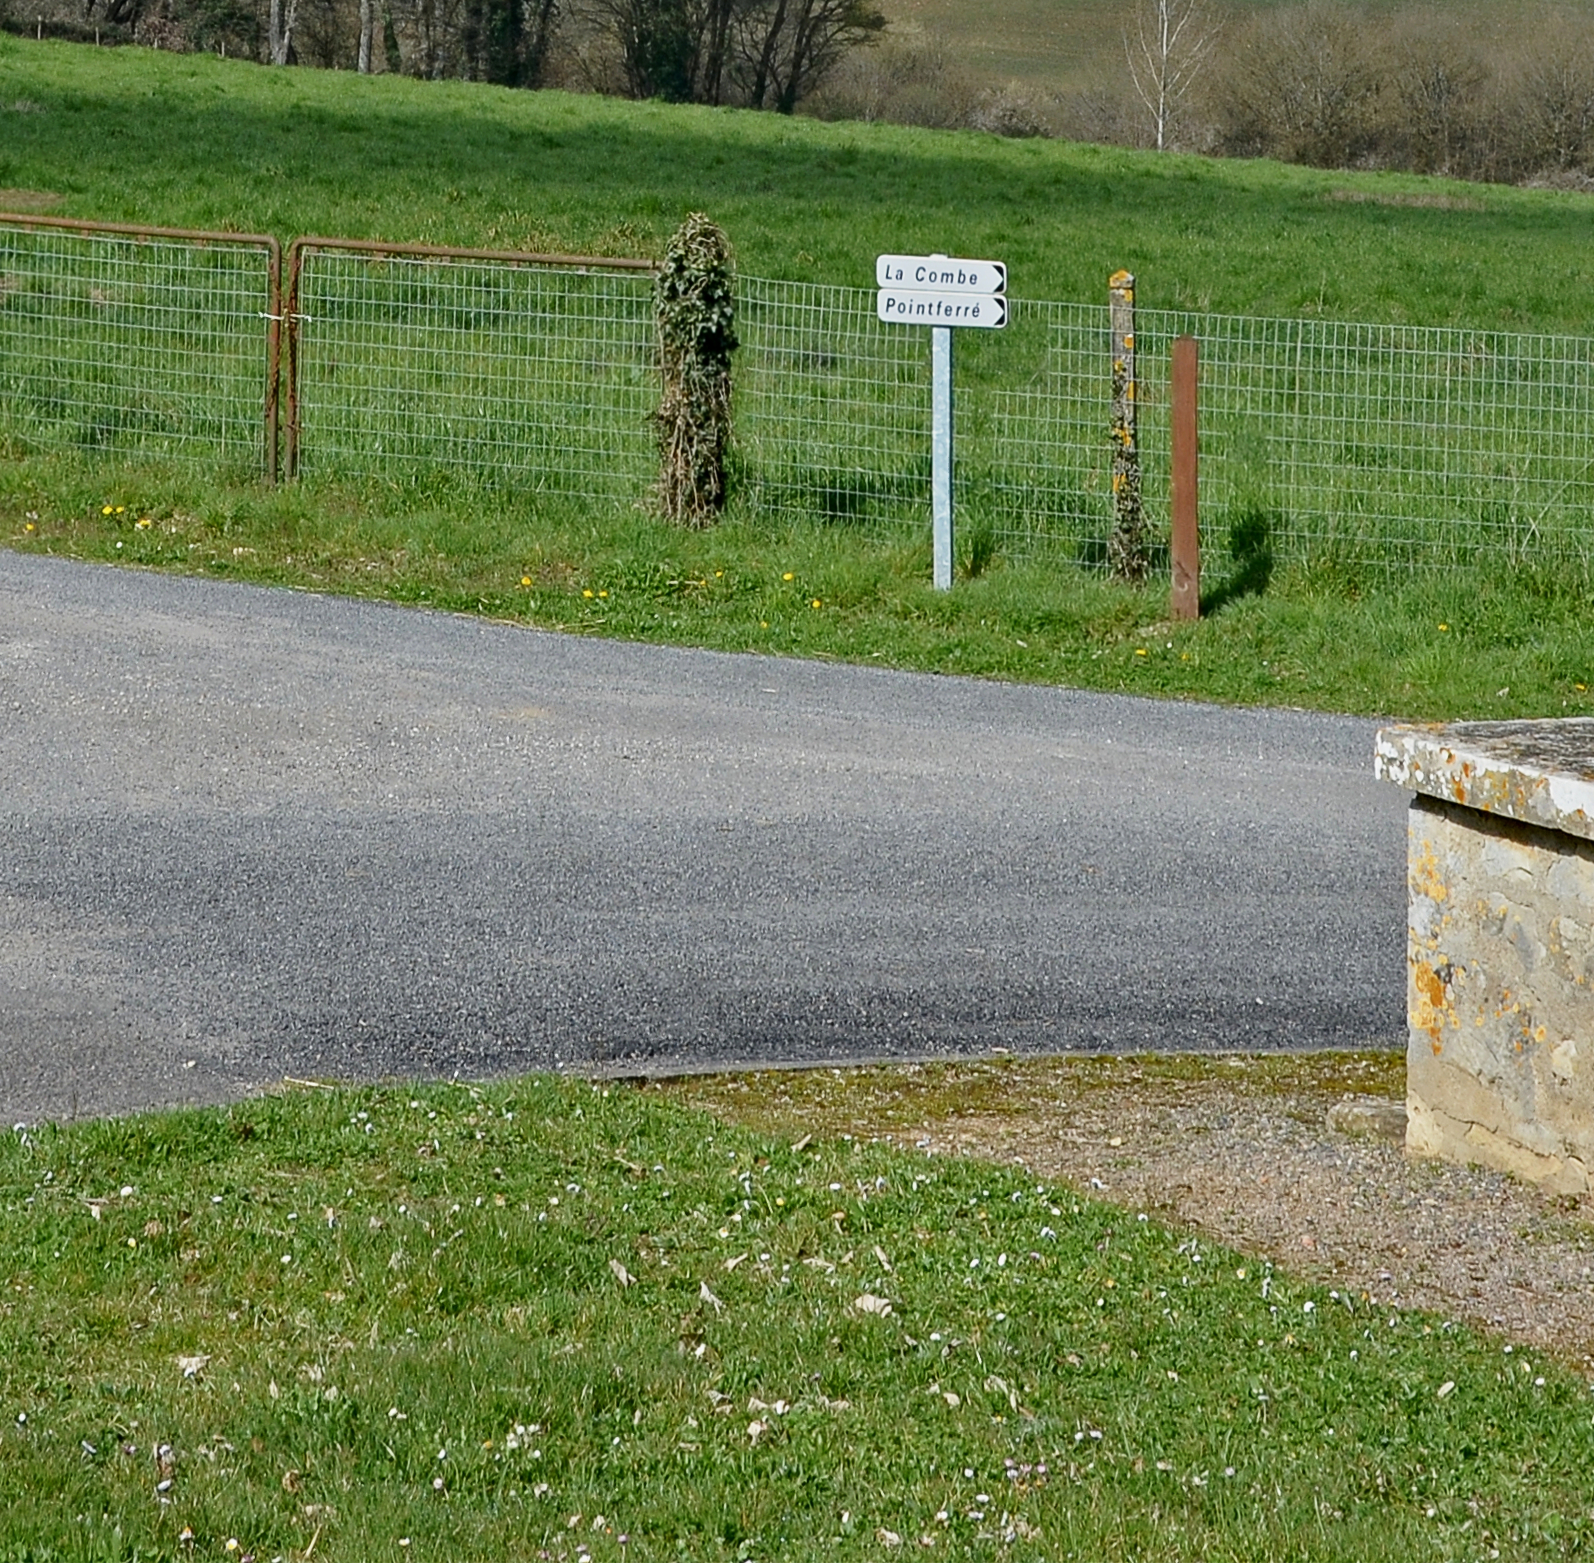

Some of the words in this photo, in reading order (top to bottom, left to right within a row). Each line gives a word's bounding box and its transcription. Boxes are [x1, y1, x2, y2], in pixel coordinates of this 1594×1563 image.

[885, 264, 904, 281] La
[915, 266, 978, 285] Combe
[885, 297, 980, 318] Pointferré
